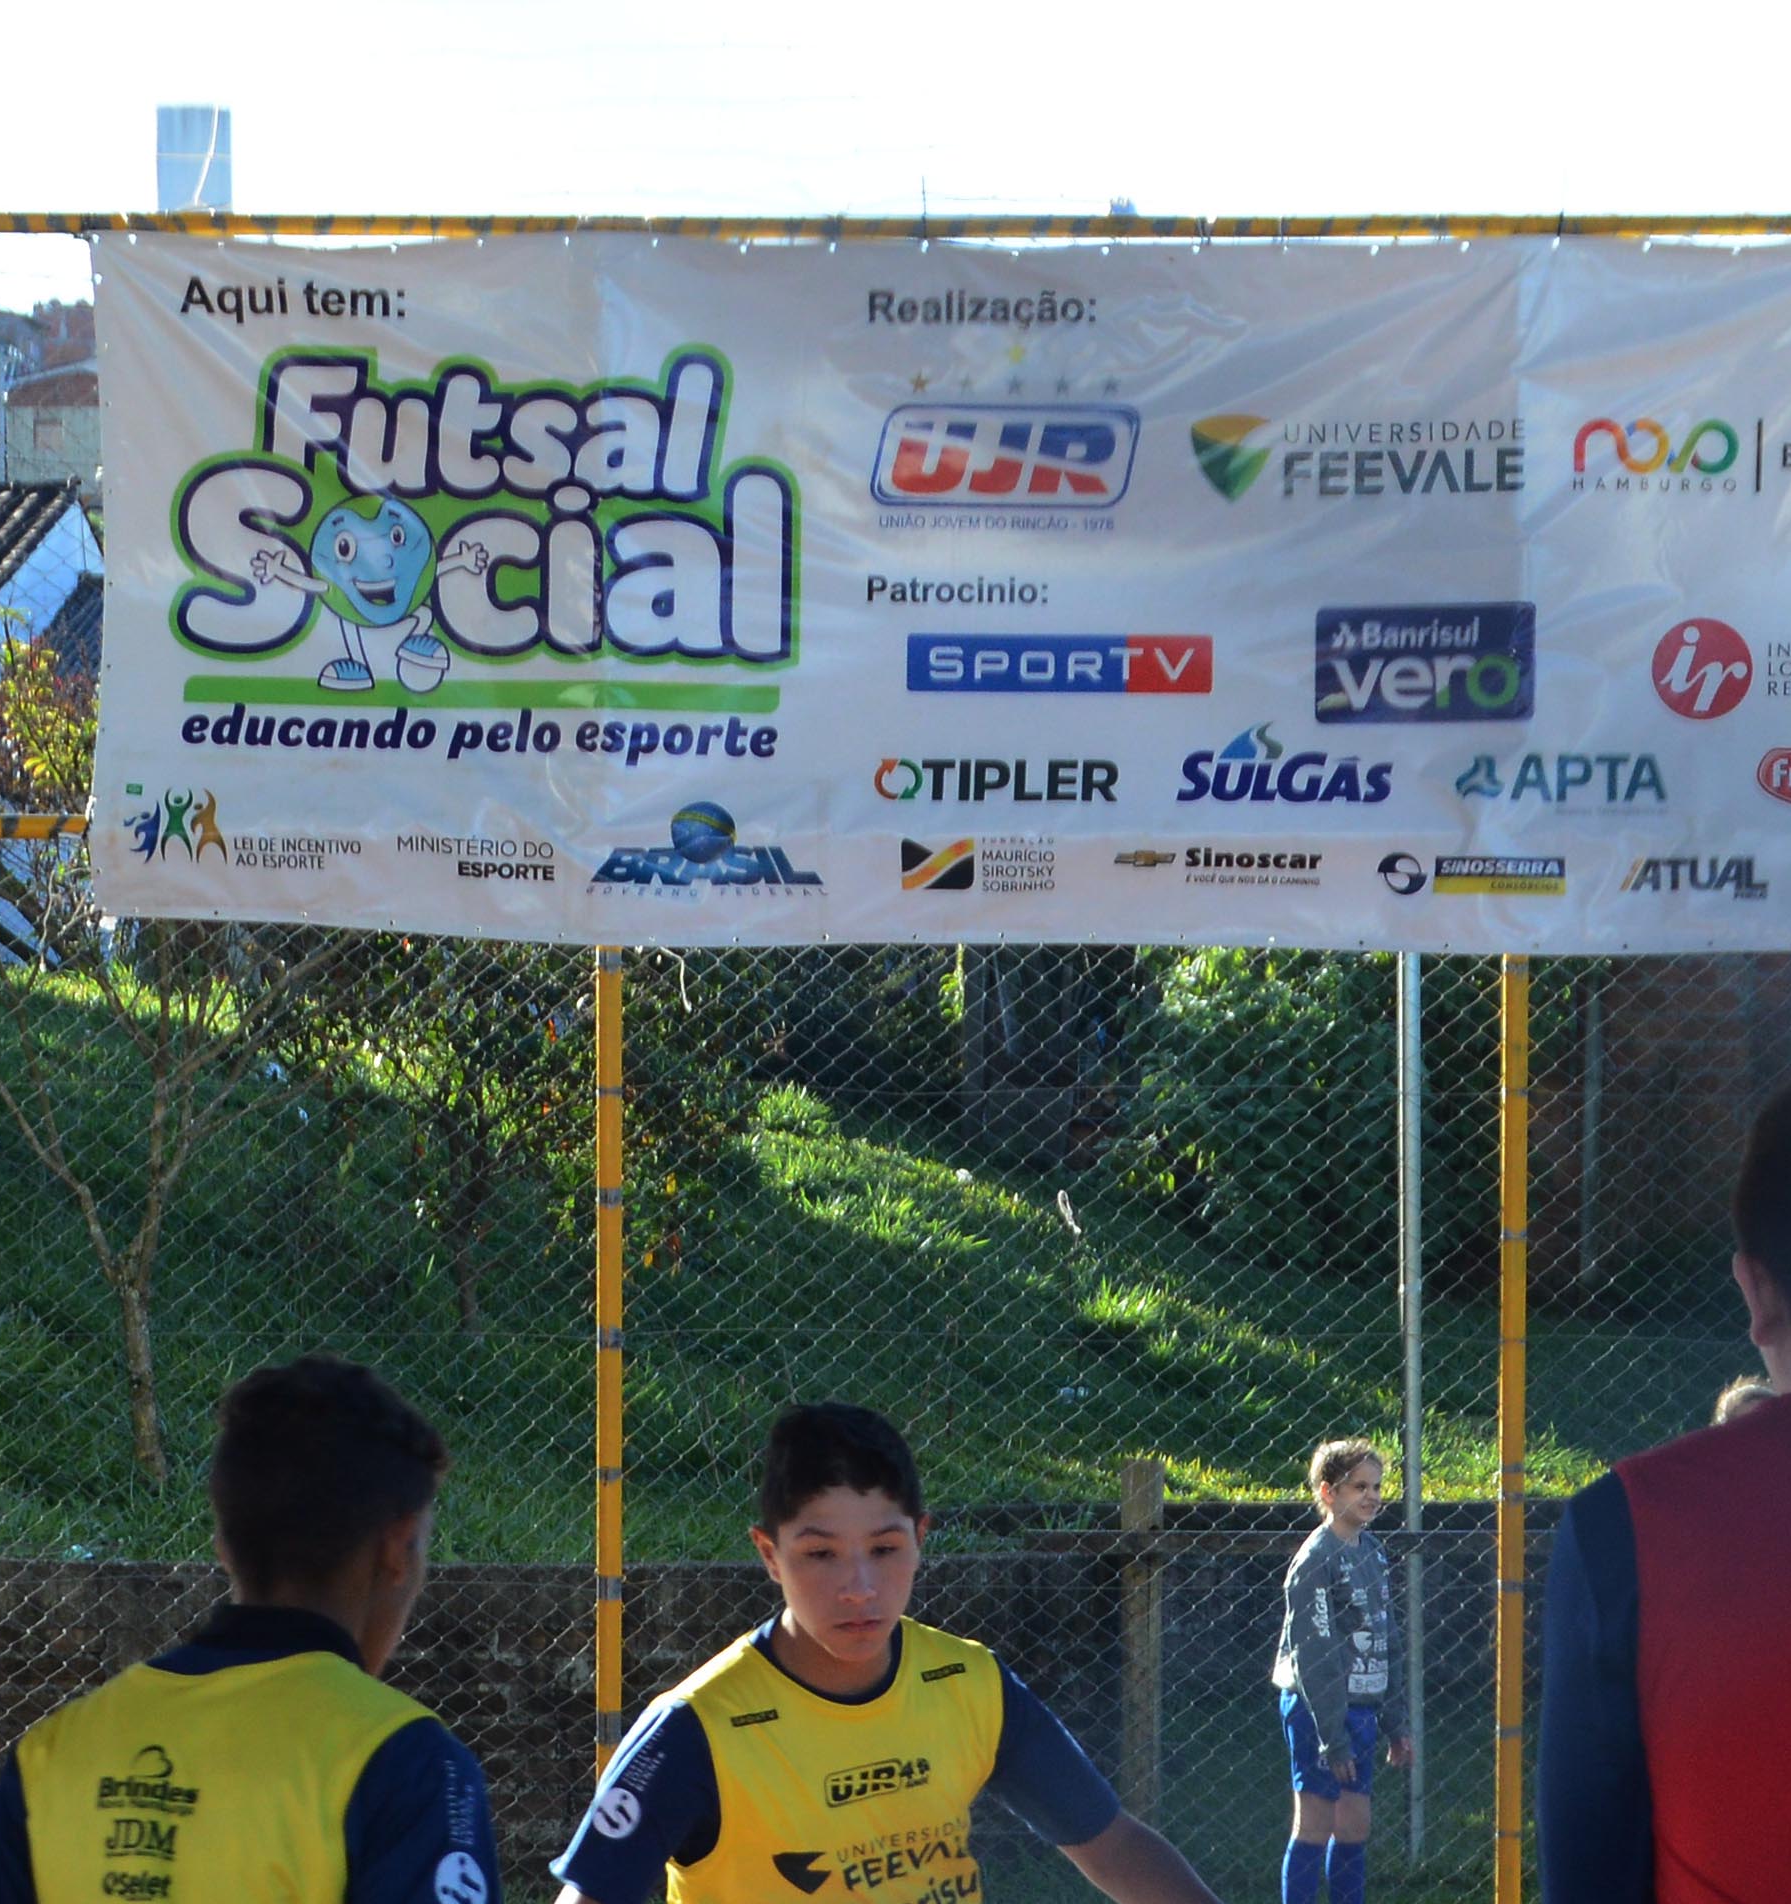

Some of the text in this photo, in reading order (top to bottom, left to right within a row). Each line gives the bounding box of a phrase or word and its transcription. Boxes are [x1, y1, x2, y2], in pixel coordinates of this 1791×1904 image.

[180, 276, 407, 320] Aqui tem:
[868, 289, 1097, 329] Realização:
[265, 354, 725, 500] Futsal
[1283, 418, 1526, 444] UNIVERSIDADE
[891, 421, 1116, 495] UJR
[1283, 447, 1526, 497] FEEVALE
[1573, 476, 1738, 492] HAMBURGO
[866, 575, 1049, 605] Patrocinio:
[1361, 616, 1480, 651] Banrisul
[928, 646, 1195, 682] SPORTV
[1337, 655, 1520, 710] vero
[182, 706, 779, 766] educando pelo esporte
[923, 758, 1119, 802] TIPLER
[1508, 752, 1668, 802] APTA
[233, 836, 362, 855] LEI DE INCENTIVO
[235, 854, 326, 870] AO ESPORTE
[397, 834, 555, 859] MINISTÉRIO DO
[982, 848, 1055, 863] MAURÍCIO
[1185, 847, 1322, 870] Sinoscar
[457, 861, 556, 882] ESPORTE
[591, 847, 823, 886] BRASIL
[982, 864, 1054, 879] SIROTSKY
[1631, 856, 1769, 892] ATUAL
[982, 880, 1056, 893] SOBRINHO
[830, 1765, 897, 1802] UJR
[104, 1818, 178, 1856] JDM
